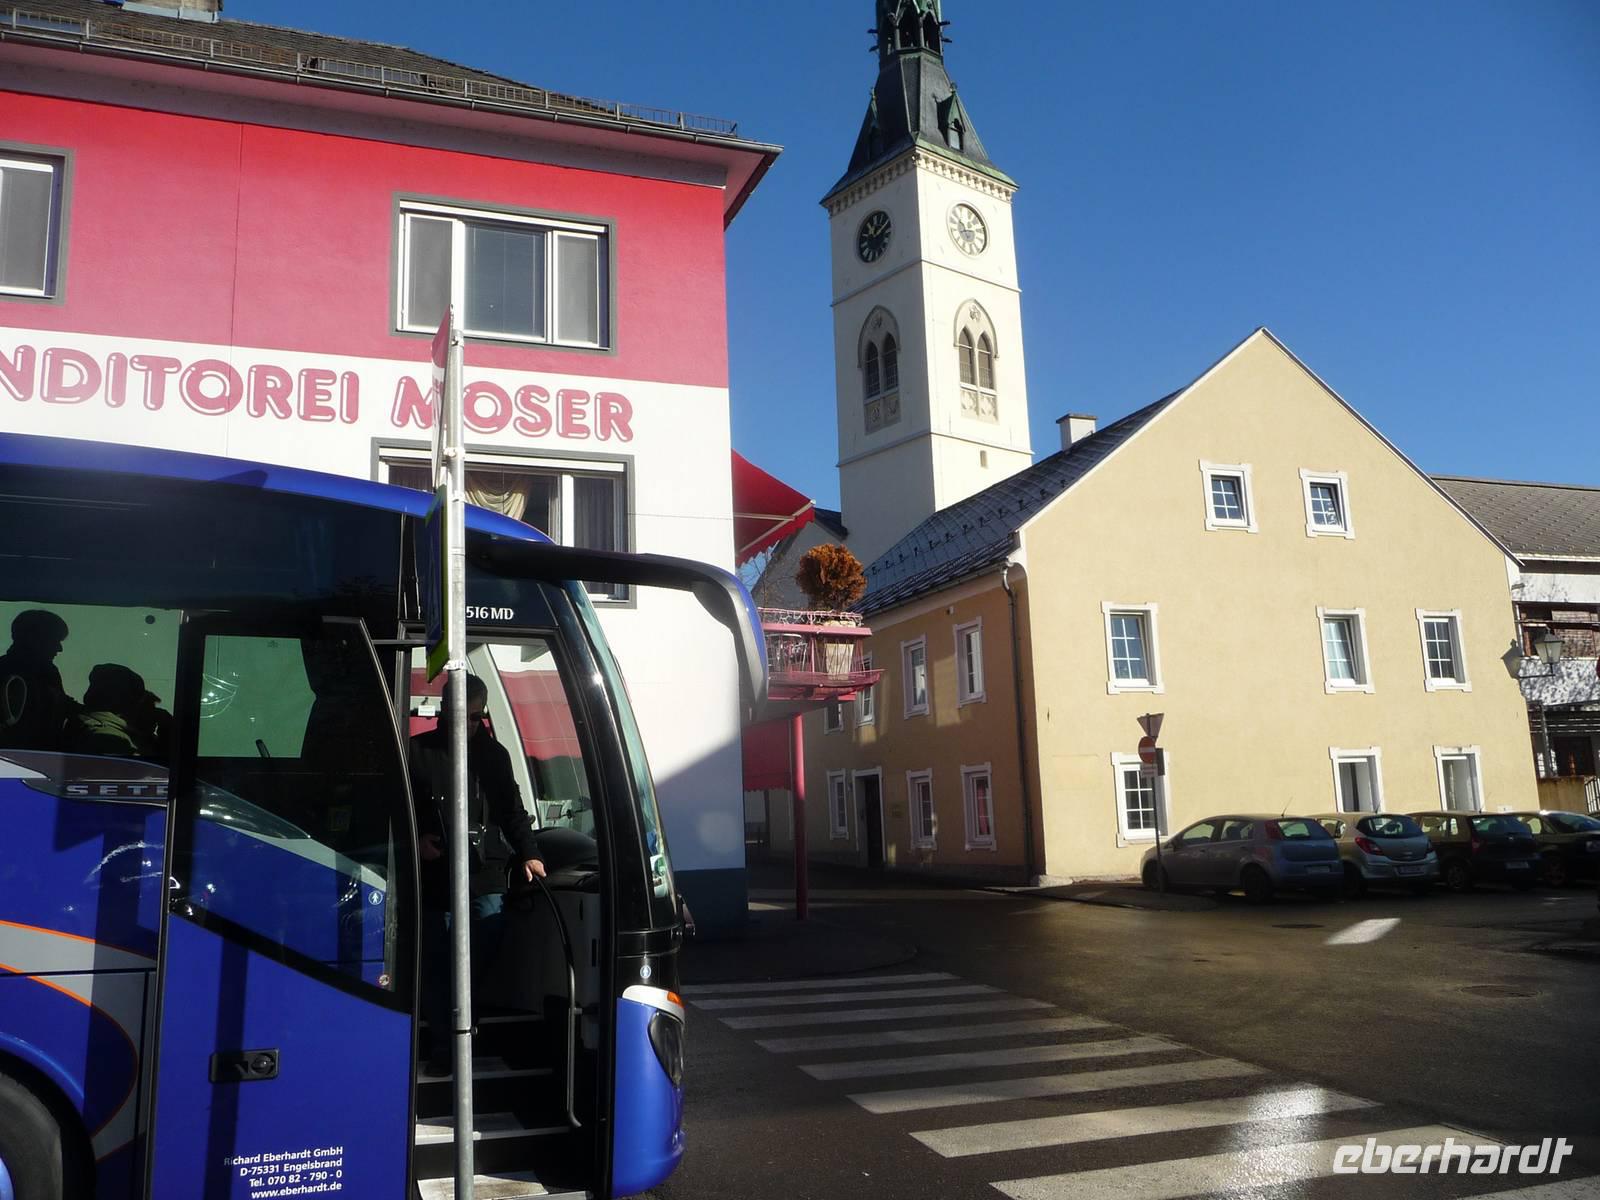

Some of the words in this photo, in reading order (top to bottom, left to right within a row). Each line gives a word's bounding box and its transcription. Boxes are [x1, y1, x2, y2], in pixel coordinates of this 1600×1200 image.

[390, 376, 634, 442] MOSER
[466, 606, 489, 619] 516
[490, 608, 514, 620] MD
[223, 1153, 261, 1166] Richard
[263, 1149, 311, 1162] Eberhardt
[313, 1146, 343, 1157] GmbH
[240, 1164, 280, 1177] D-75331
[283, 1157, 343, 1173] Engelsbrand
[249, 1177, 265, 1187] Tel.
[267, 1175, 286, 1186] 070
[288, 1173, 301, 1183] 82
[309, 1170, 328, 1181] 790
[336, 1169, 343, 1179] 0
[251, 1181, 342, 1199] www.eberhardt.de
